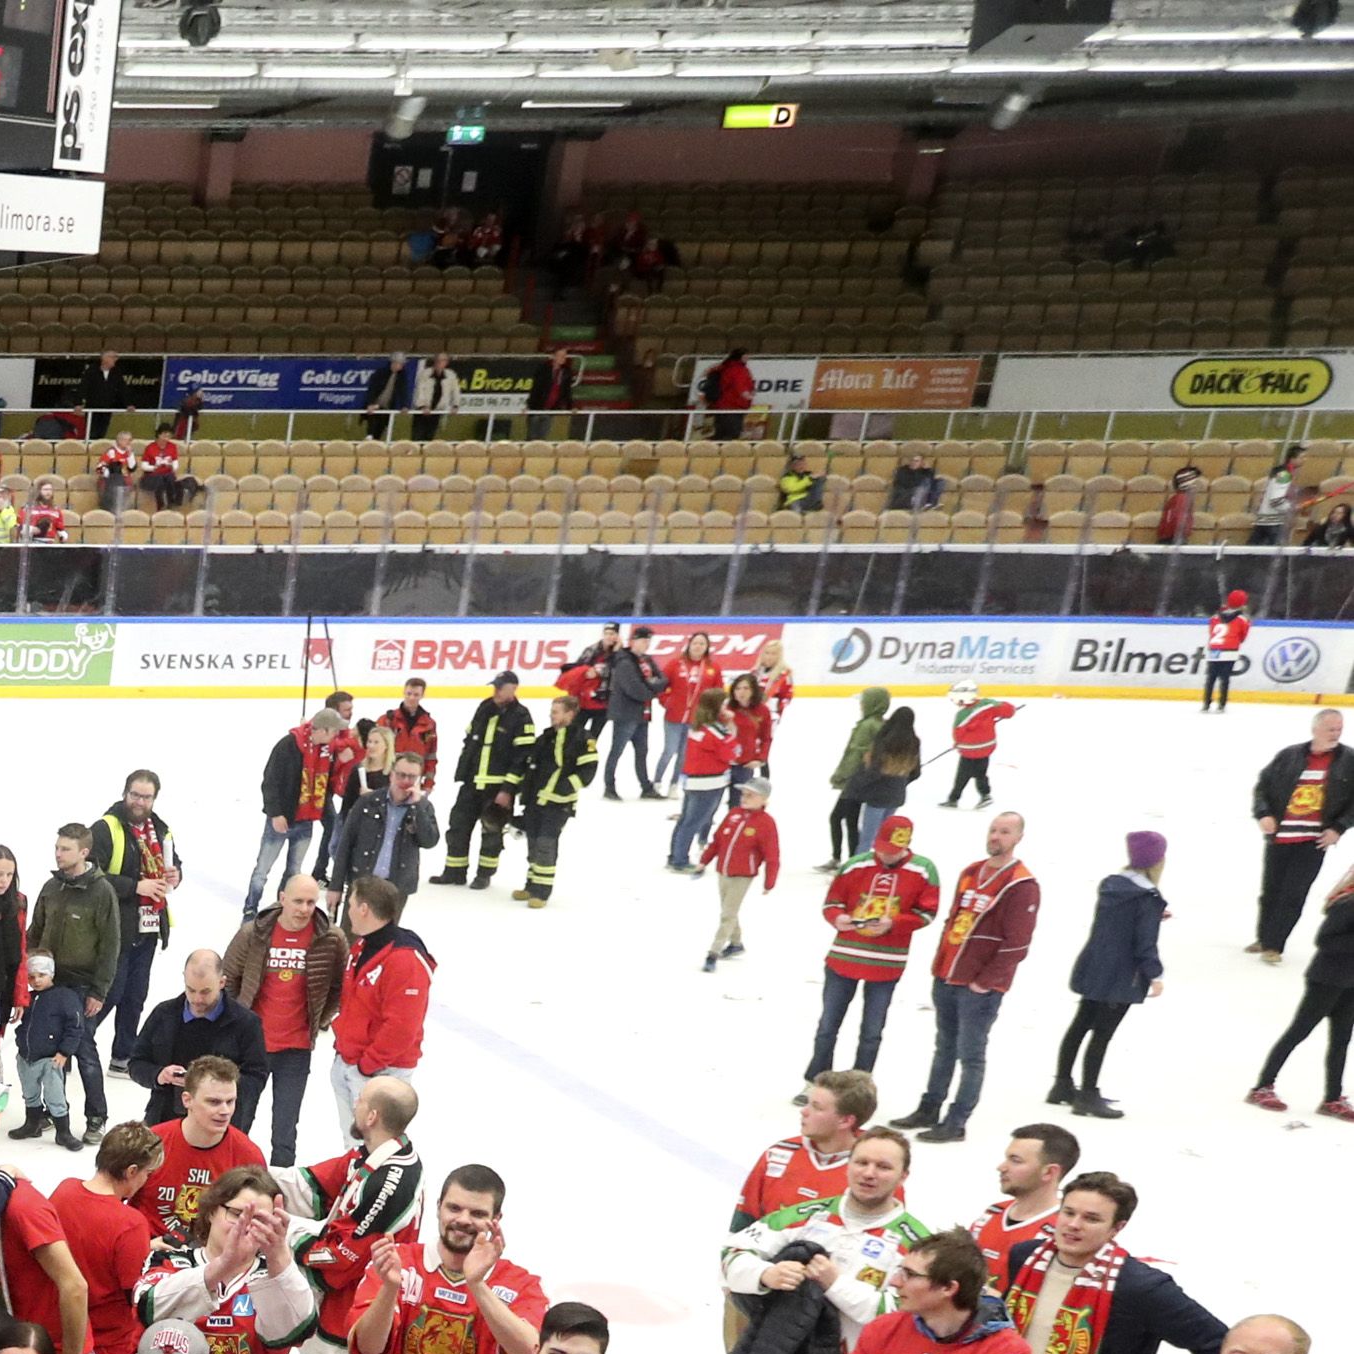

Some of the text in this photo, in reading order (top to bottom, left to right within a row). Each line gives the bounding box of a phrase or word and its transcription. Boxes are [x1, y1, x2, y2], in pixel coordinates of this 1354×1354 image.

[470, 368, 534, 391] BYGG AB
[816, 368, 874, 391] Mora
[882, 367, 919, 389] Life
[1189, 369, 1311, 394] DÄCK FÄLG
[1211, 623, 1227, 645] 2
[410, 639, 571, 671] BRAHUS
[878, 634, 1040, 661] DynaMate
[1070, 637, 1250, 679] Bilmeto
[140, 652, 291, 670] SVENSKA SPEL
[914, 662, 1036, 675] Industrial Services
[187, 1167, 212, 1184] SHL
[157, 1186, 175, 1202] 20
[355, 1164, 405, 1238] FM Mattsson
[208, 1316, 231, 1326] WIBE
